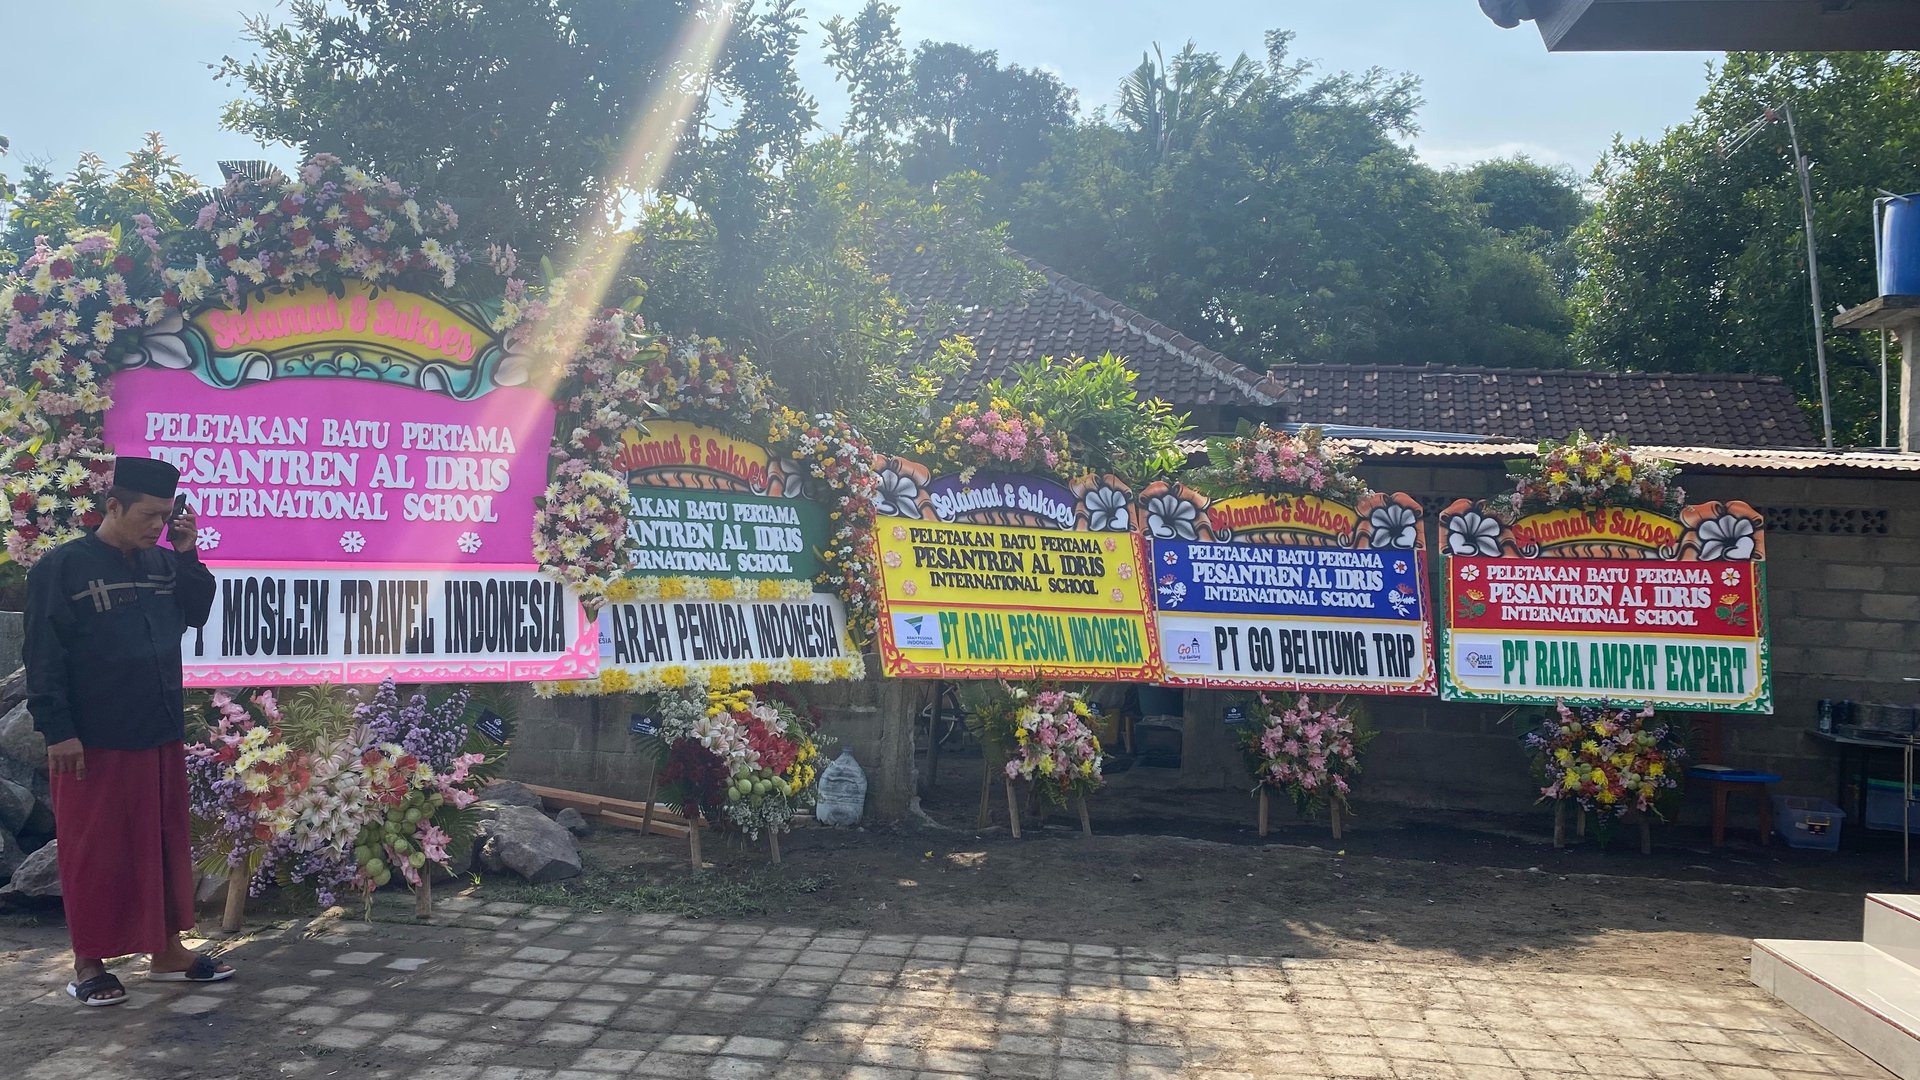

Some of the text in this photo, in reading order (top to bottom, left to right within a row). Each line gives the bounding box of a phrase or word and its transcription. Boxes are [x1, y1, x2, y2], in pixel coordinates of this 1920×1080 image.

[209, 295, 477, 362] Selamat & Sukses
[145, 412, 516, 455] PELETAKAN BATU PERTAMA
[369, 454, 415, 490] AL
[424, 457, 510, 493] IDRIS
[689, 434, 702, 464] &
[705, 438, 769, 489] Sukses
[175, 488, 499, 524] NTERNATIONAL SCHOOL
[628, 497, 801, 526] AKAN BATU PERTAMA
[930, 482, 1076, 527] Selamat & Sukses
[1208, 498, 1353, 535] Selamat & Sukses
[720, 524, 748, 551] AL
[753, 526, 804, 553] IDRIS
[909, 527, 1103, 554] PELETAKAN BATU PERTAMA
[1512, 510, 1676, 548] Selamat & Sukses
[738, 553, 793, 573] SCHOOL
[913, 546, 1106, 577] PESANTREN AL IDRIS
[1188, 545, 1384, 569] PELETAKAN BATU PERTAMA
[930, 571, 1099, 595] INTERNATIONAL SCHOOL
[1191, 563, 1384, 592] PESANTREN AL IDRIS
[1486, 565, 1714, 585] PELETAKAN BATU PERTAMA
[1204, 585, 1374, 609] INTERNATIONAL SCHOOL
[1489, 583, 1711, 609] PESANTREN AL IDRIS
[221, 576, 566, 657] MOSLEM TRAVEL INDONESIA
[1501, 606, 1698, 627] INTERNATIONAL SCHOOL
[612, 603, 841, 664] ARAH PEMUDA INDONESIA
[938, 611, 1144, 663] PT ARAH PESONA INDONESIA
[1178, 643, 1191, 655] Go
[1214, 626, 1415, 677] PT GO BELITUNG TRIP
[1502, 639, 1747, 694] PT RAJA AMPAT EXPERT
